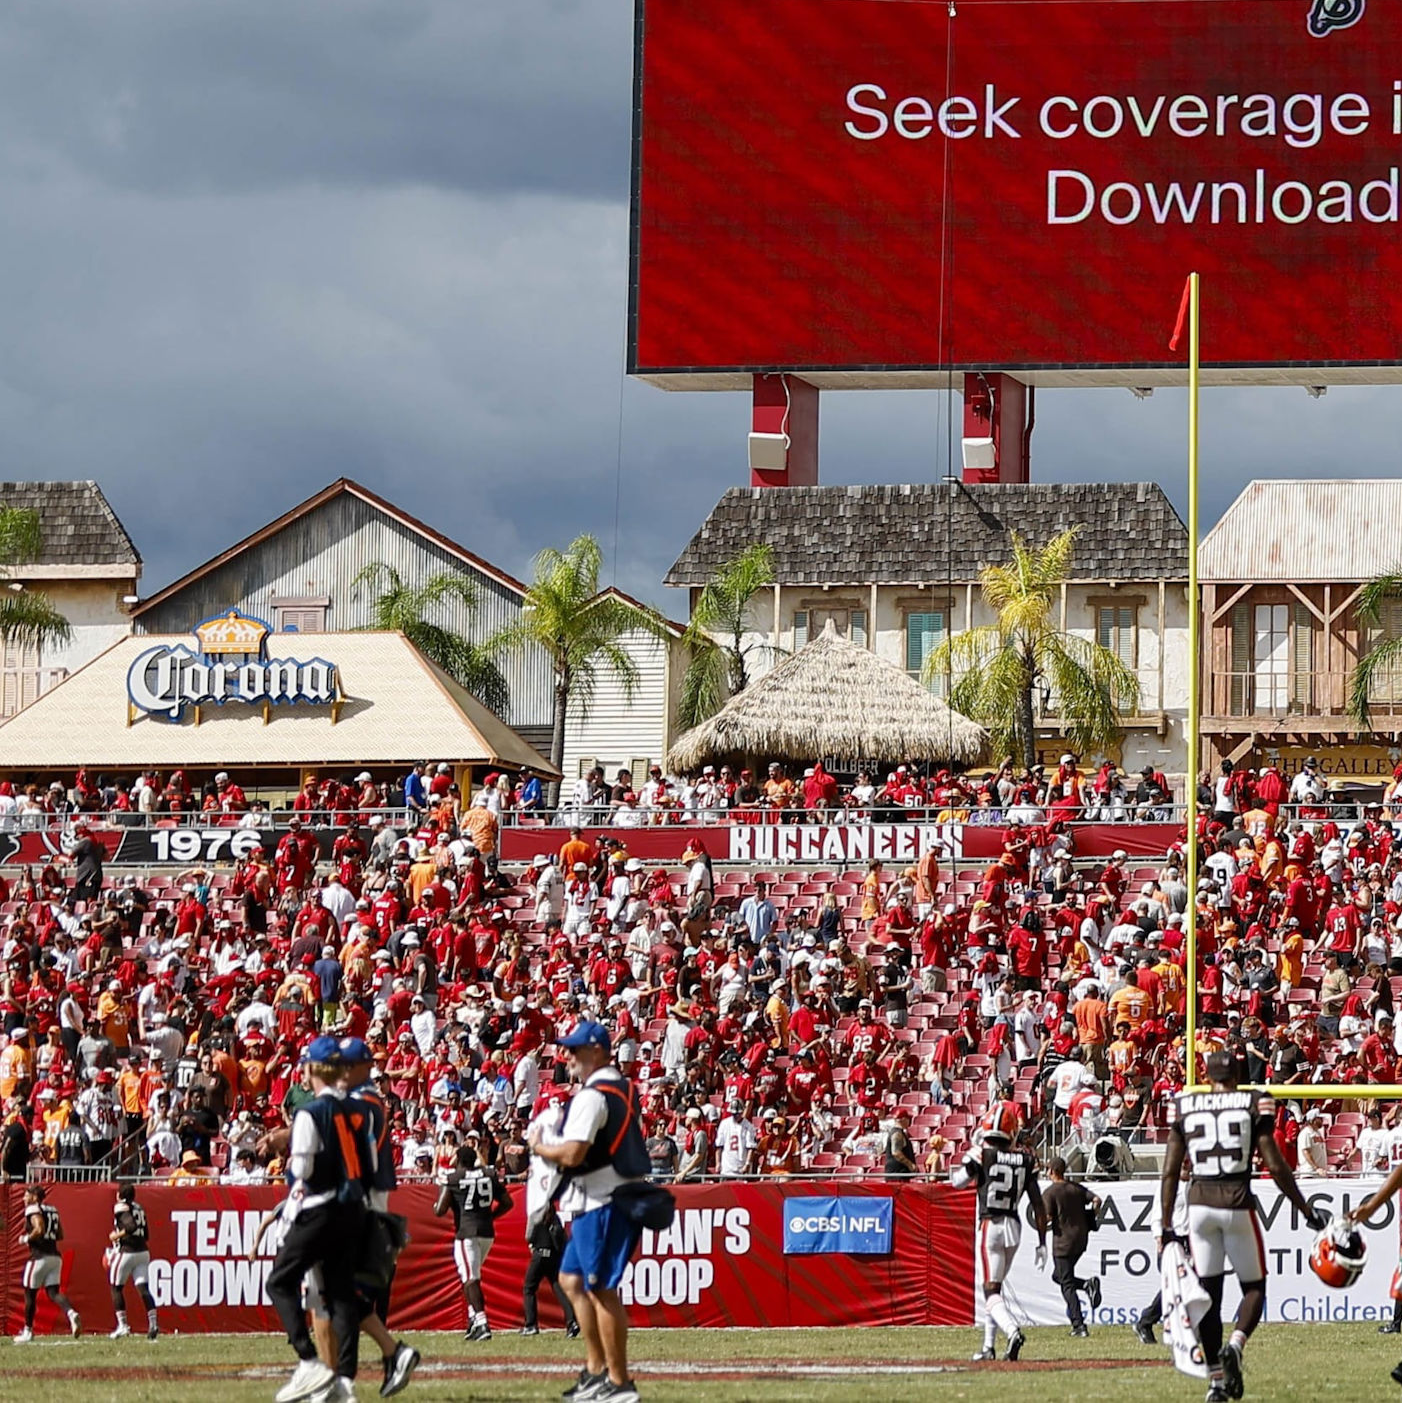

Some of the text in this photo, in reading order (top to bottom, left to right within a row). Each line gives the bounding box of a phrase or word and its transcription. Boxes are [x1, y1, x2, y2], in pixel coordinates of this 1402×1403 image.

[844, 83, 1022, 140] Seek
[1039, 92, 1370, 149] coverage
[1047, 167, 1399, 225] Download
[130, 645, 335, 717] Corona
[852, 758, 879, 776] BEER
[904, 794, 921, 807] 50
[150, 829, 264, 861] 1976
[729, 824, 963, 861] BUCCANEERS
[285, 864, 295, 880] 7
[1217, 868, 1227, 886] 9
[1333, 917, 1347, 931] 13
[1029, 938, 1037, 952] 7
[852, 1036, 872, 1052] 82
[1114, 1047, 1127, 1064] 14
[1274, 1050, 1283, 1071] 1
[177, 1068, 194, 1087] 10
[281, 1063, 292, 1078] 7
[639, 1065, 650, 1080] 8
[865, 1078, 875, 1096] 2
[1181, 1091, 1252, 1113] BLACKMON
[730, 1134, 738, 1151] 2
[1184, 1111, 1252, 1176] 29
[996, 1150, 1022, 1165] WARD
[459, 1176, 494, 1211] 79
[988, 1163, 1025, 1210] 21
[1254, 1192, 1397, 1230] VISIO
[171, 1210, 280, 1257] TEAM
[804, 1216, 886, 1234] CBS NFL
[148, 1258, 274, 1307] GODWI
[617, 1258, 714, 1306] ROOP
